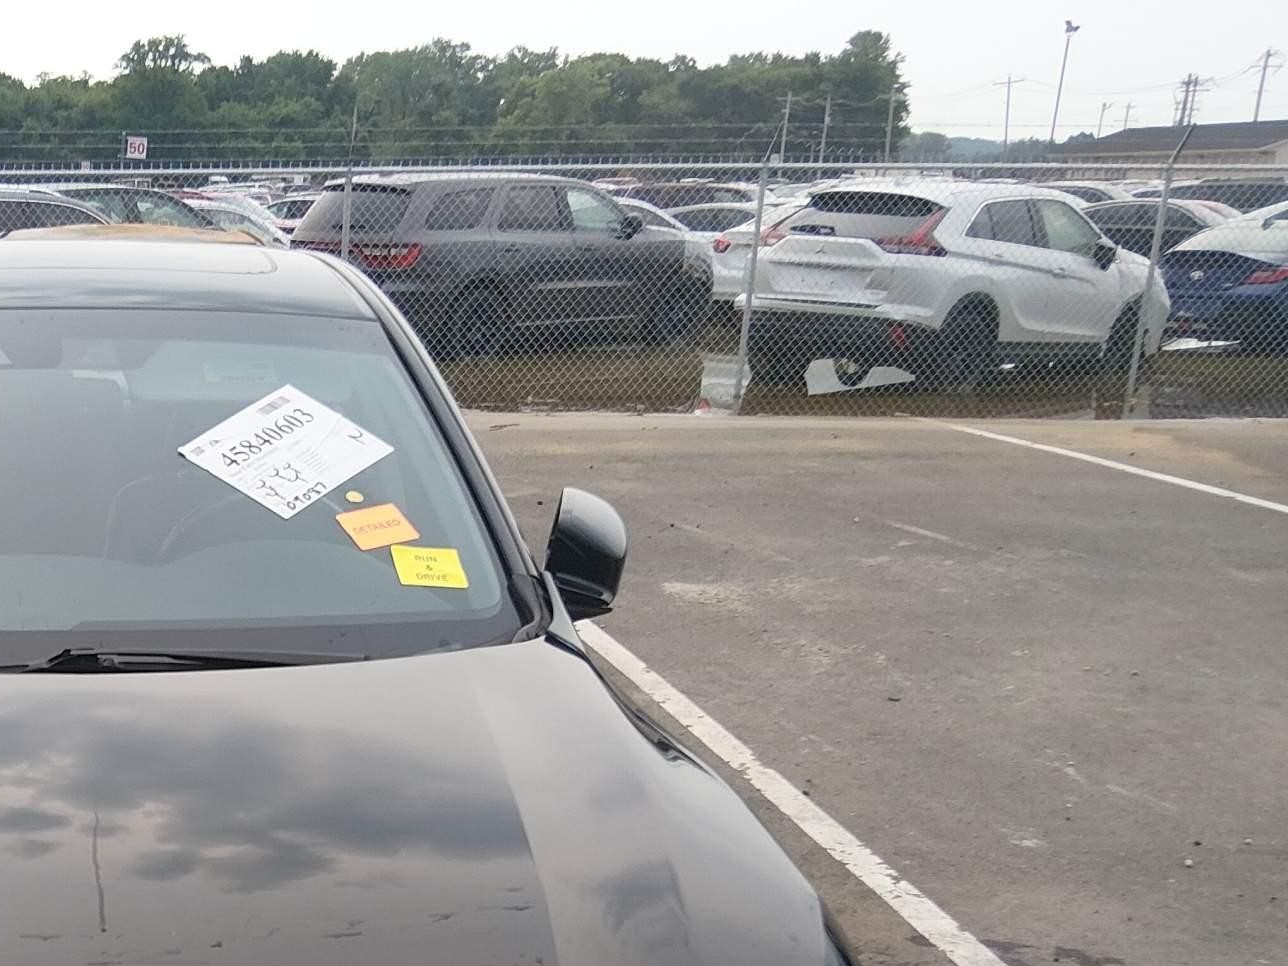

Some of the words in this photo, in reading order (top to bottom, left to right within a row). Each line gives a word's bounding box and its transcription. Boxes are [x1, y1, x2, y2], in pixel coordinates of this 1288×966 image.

[129, 142, 145, 154] 50
[221, 408, 314, 468] 45840603
[415, 573, 449, 582] DRIVE
